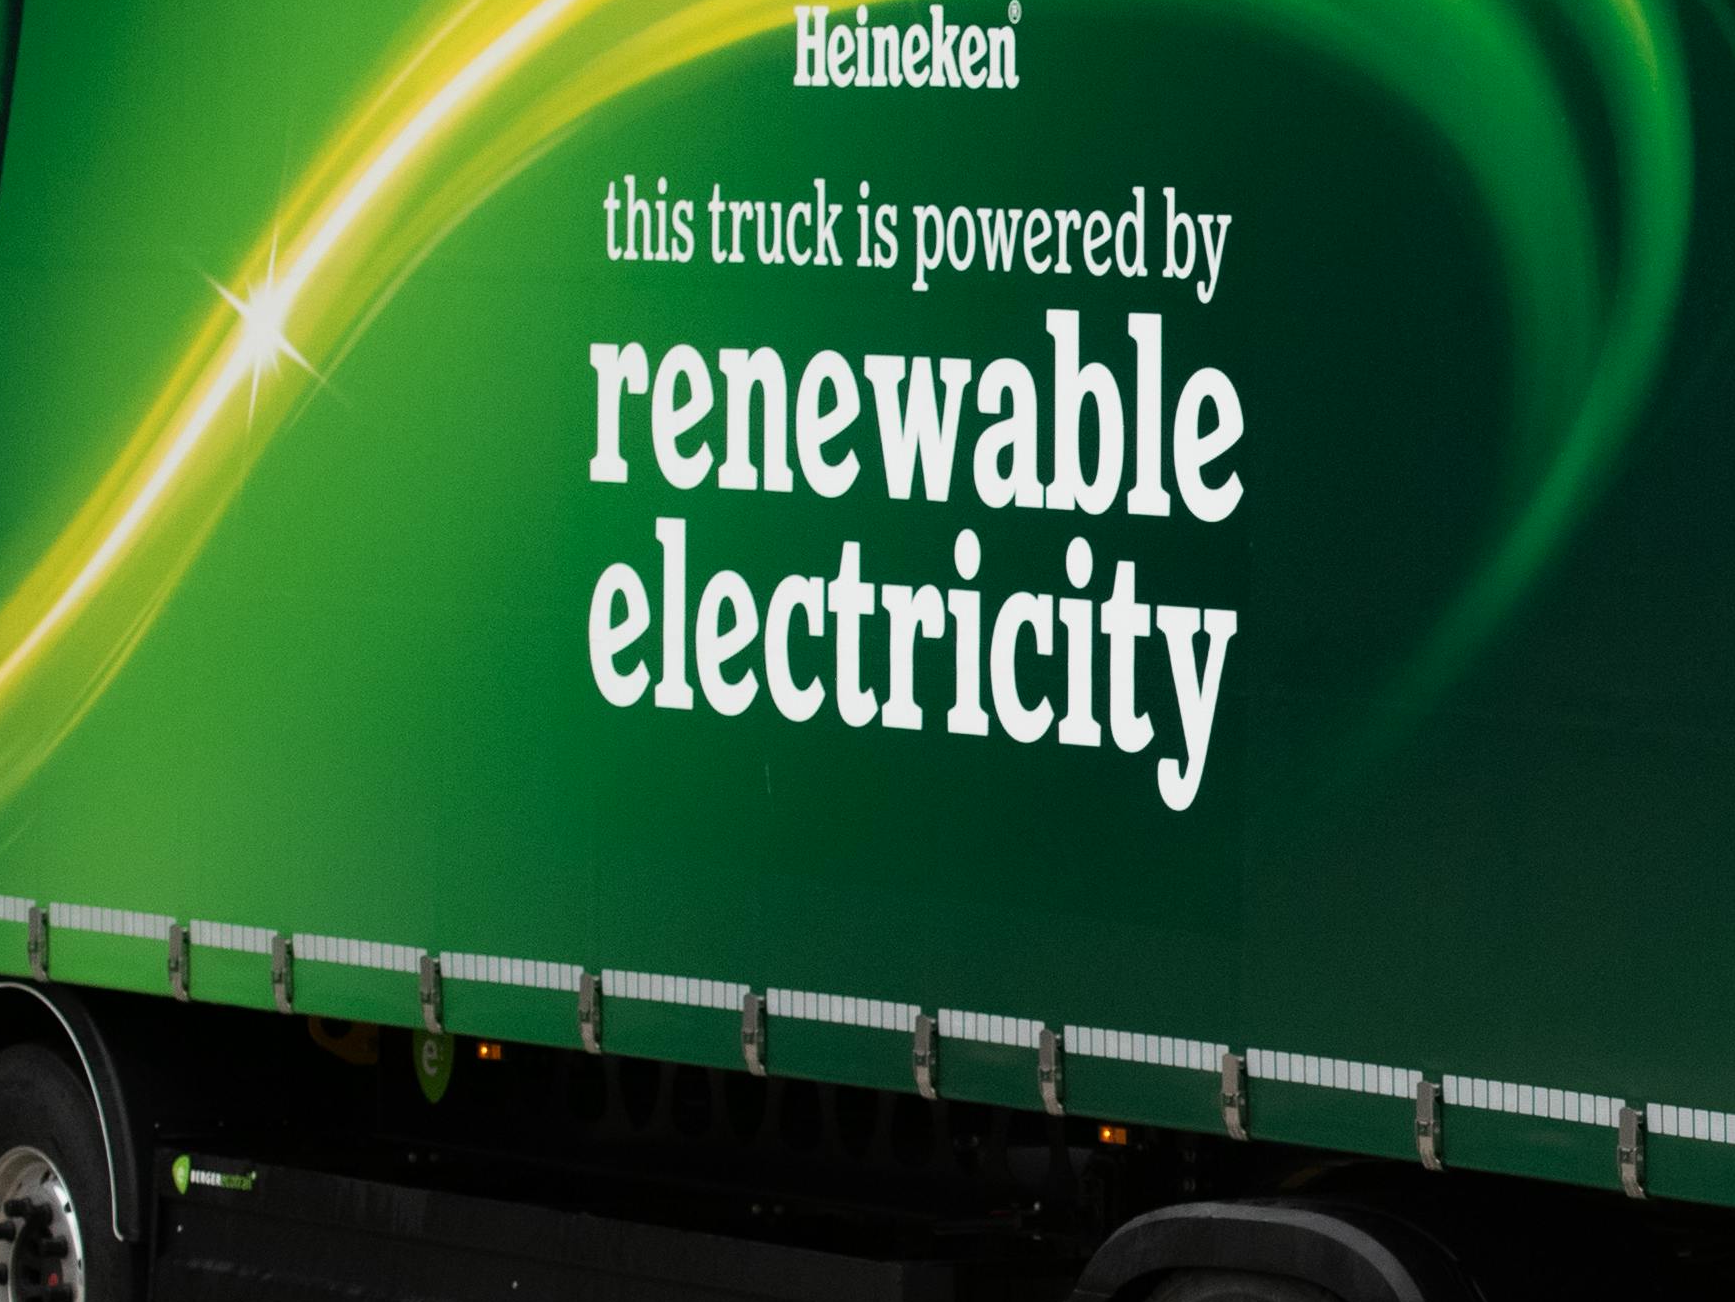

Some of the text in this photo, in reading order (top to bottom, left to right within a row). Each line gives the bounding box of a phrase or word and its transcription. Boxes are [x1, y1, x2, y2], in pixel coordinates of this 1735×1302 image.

[604, 174, 1232, 303] this truck is powered by
[589, 308, 1246, 523] renewable
[588, 516, 1238, 812] electricity
